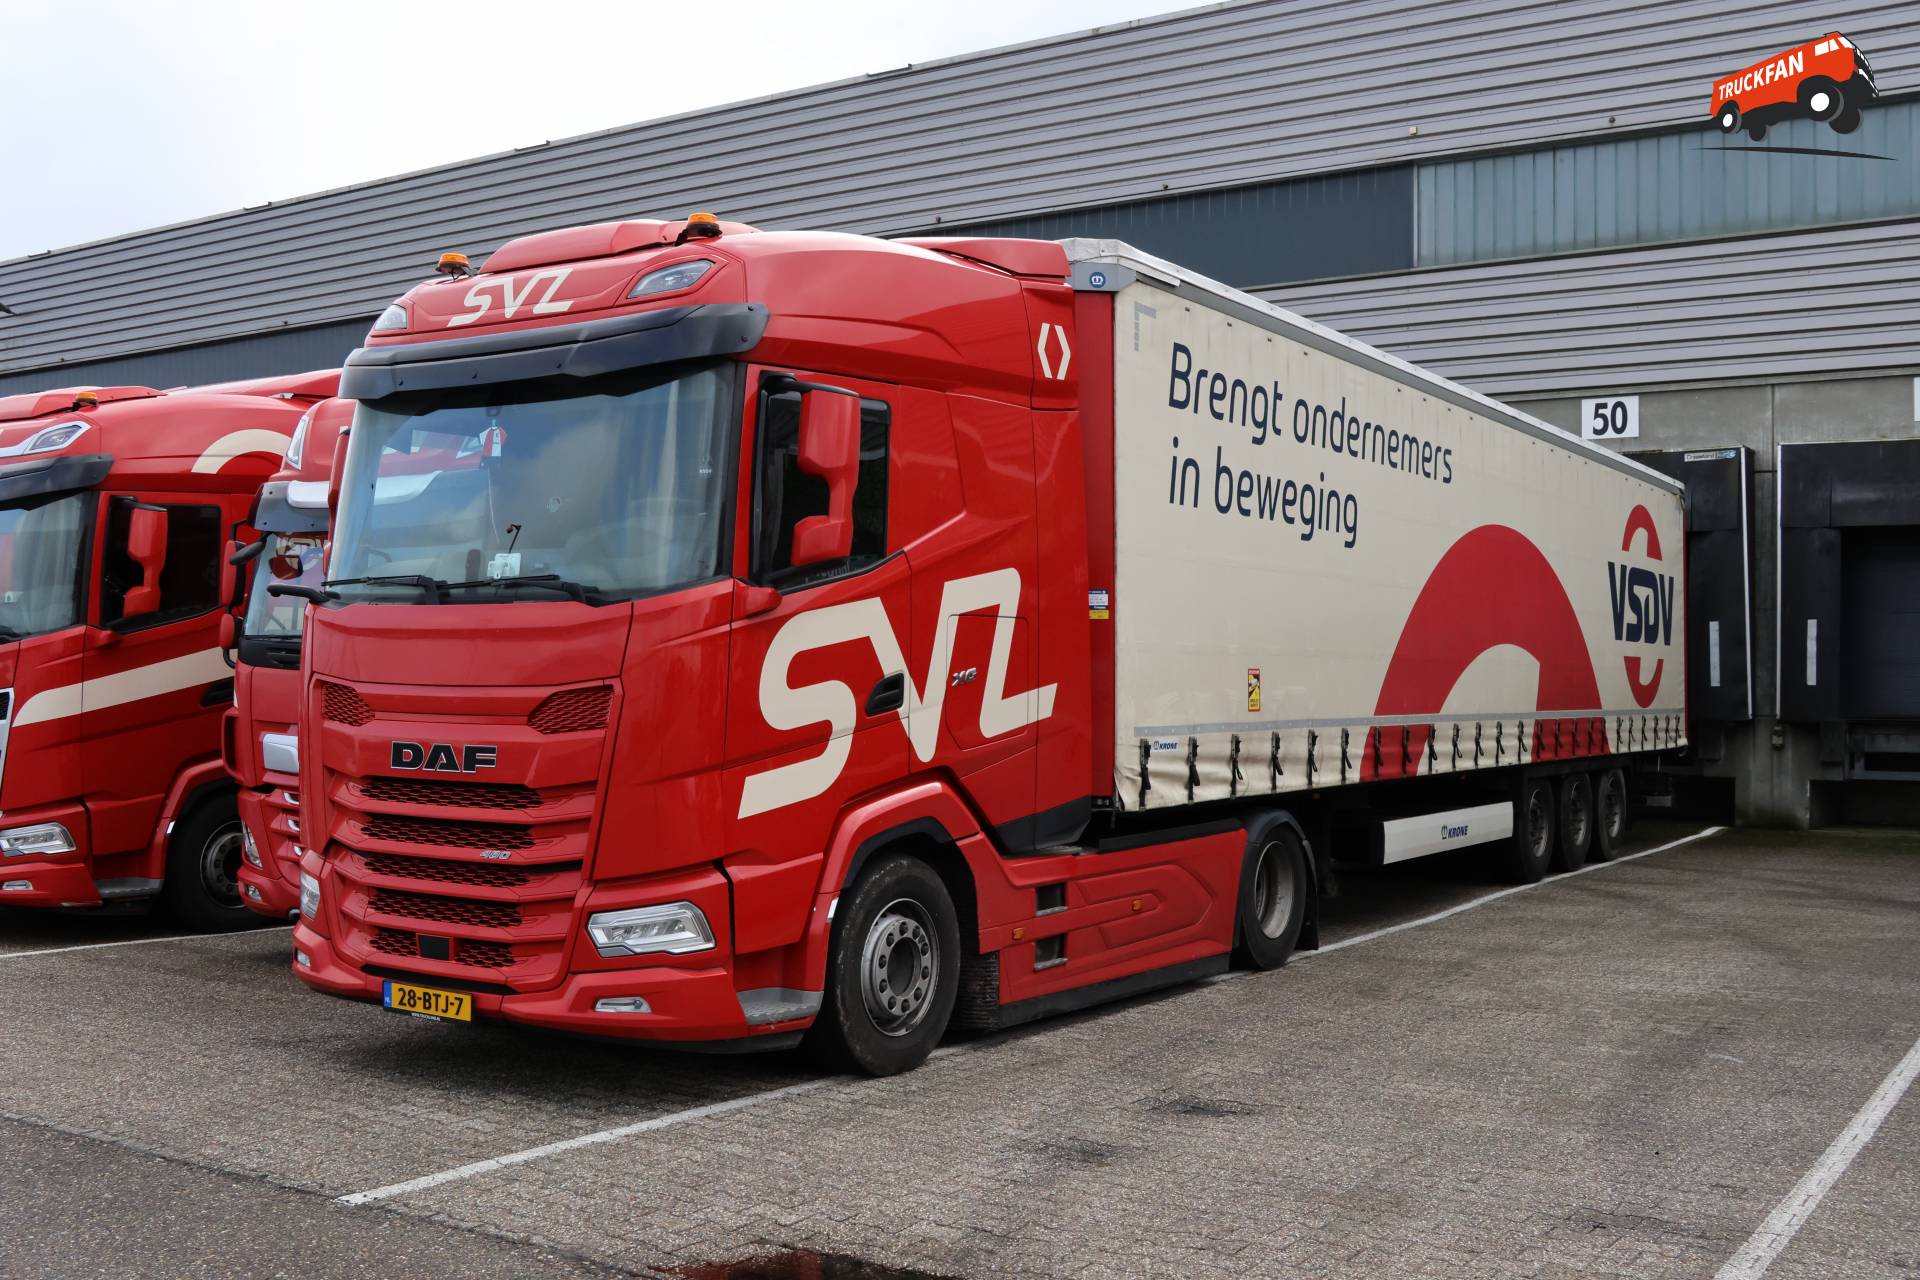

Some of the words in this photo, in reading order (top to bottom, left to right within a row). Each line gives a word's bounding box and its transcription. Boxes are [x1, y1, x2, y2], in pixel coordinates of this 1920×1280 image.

[447, 268, 575, 327] SVZ
[1168, 341, 1283, 446] Brengt
[1293, 396, 1453, 484] ondernemers
[1592, 400, 1628, 436] 50
[1169, 436, 1200, 508] in
[1214, 445, 1358, 549] beweging
[1608, 561, 1675, 646] VSDV
[737, 567, 1058, 820] SVZ
[951, 667, 977, 687] XG
[390, 740, 498, 773] DAF
[1447, 825, 1469, 839] KRONE
[397, 987, 464, 1016] 28-BTJ-7
